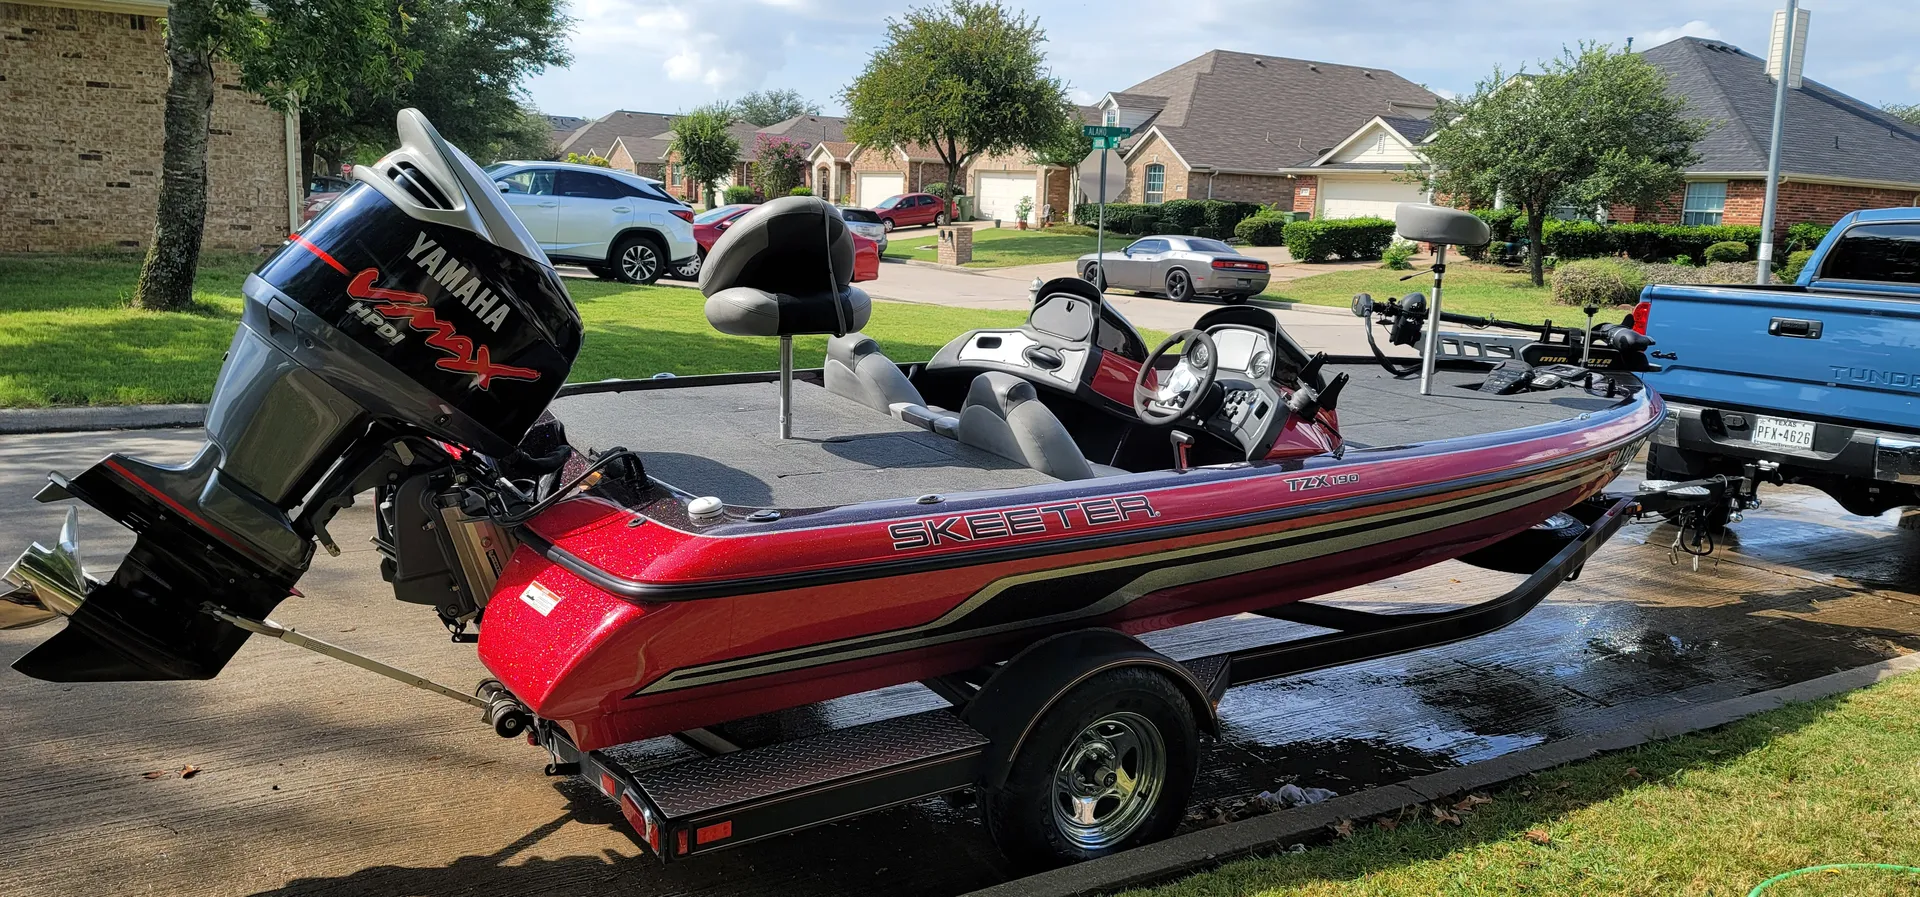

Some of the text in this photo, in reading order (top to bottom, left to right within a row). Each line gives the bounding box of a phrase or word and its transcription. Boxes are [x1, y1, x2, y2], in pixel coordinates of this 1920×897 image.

[1088, 128, 1106, 136] ALAMO
[407, 231, 510, 332] YAMAHA
[348, 302, 405, 345] HPDI
[1774, 419, 1797, 428] TEXAS
[1282, 472, 1360, 492] TZX 190
[888, 495, 1156, 550] SKEETER
